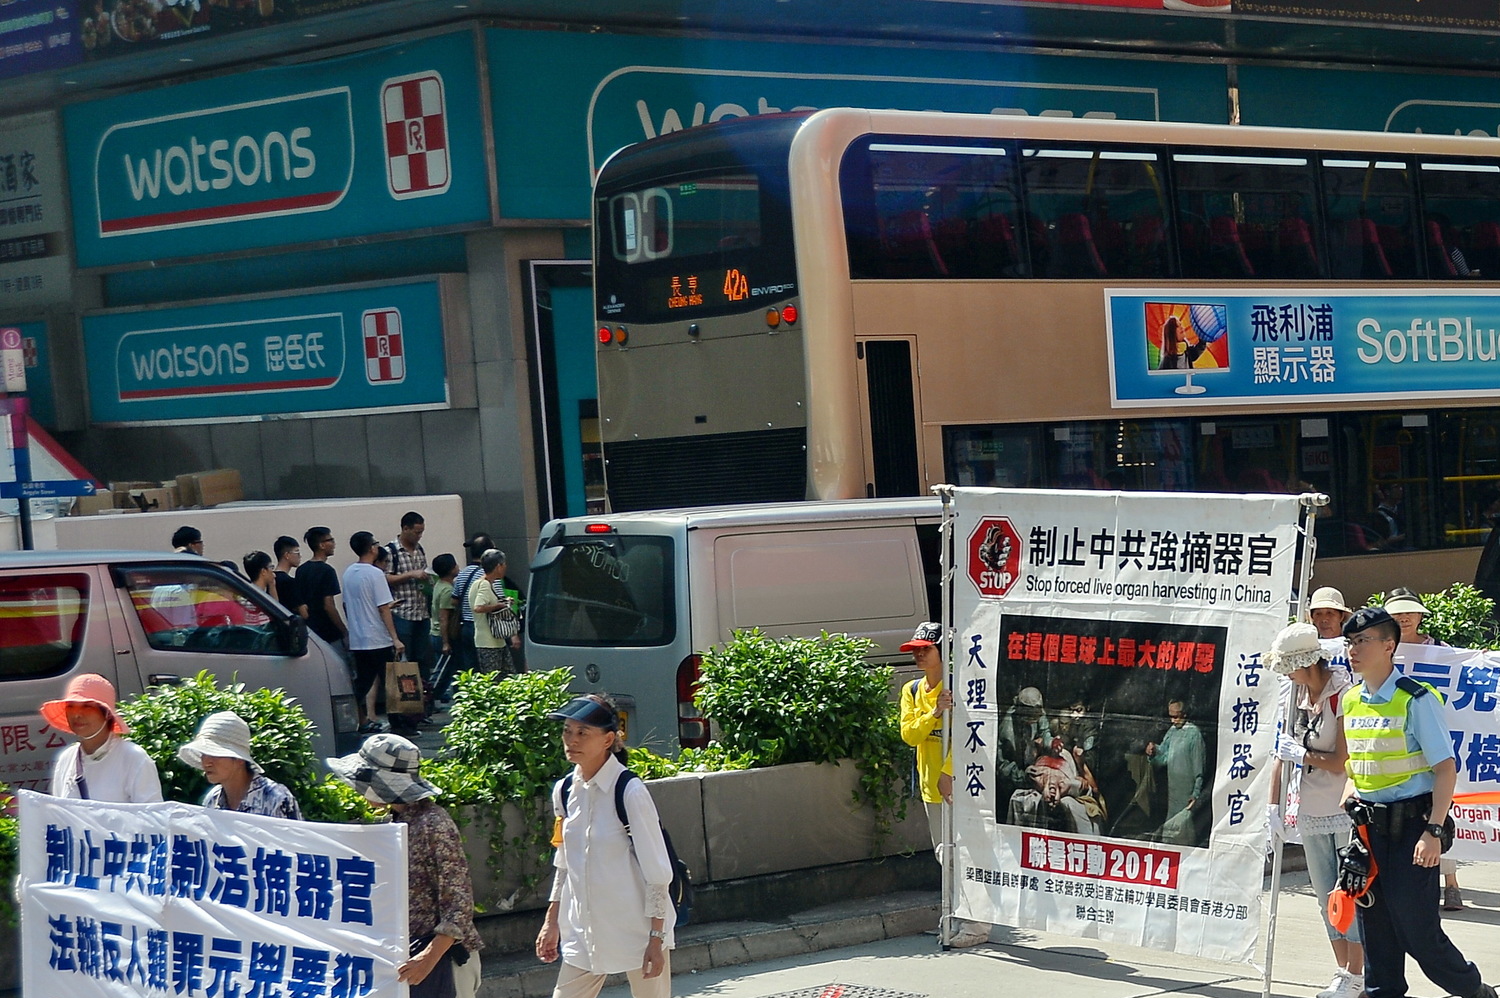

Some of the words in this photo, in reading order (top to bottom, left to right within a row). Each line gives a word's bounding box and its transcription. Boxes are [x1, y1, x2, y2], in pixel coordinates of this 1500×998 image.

[125, 127, 316, 200] watsons
[723, 269, 749, 301] 42A
[1251, 303, 1334, 342] 飛利浦
[131, 344, 249, 382] watsons
[264, 332, 326, 374] 屈臣氏
[1253, 346, 1336, 384] 顯示器
[1028, 526, 1277, 577] 制止中共強摘器官
[979, 570, 1012, 590] STOP
[1026, 575, 1051, 596] Stop
[1054, 576, 1091, 594] forced
[1093, 577, 1112, 595] live
[1115, 582, 1148, 600] organ
[1152, 581, 1217, 604] harvesting
[1220, 584, 1231, 601] in
[1234, 584, 1271, 603] China
[1007, 632, 1215, 674] 在這個星球上最大的邪惡
[965, 634, 987, 798] 天理不容
[0, 724, 67, 755] 限公
[1227, 653, 1264, 827] 活摘器官
[1453, 805, 1491, 823] Organ
[1454, 828, 1487, 844] uang
